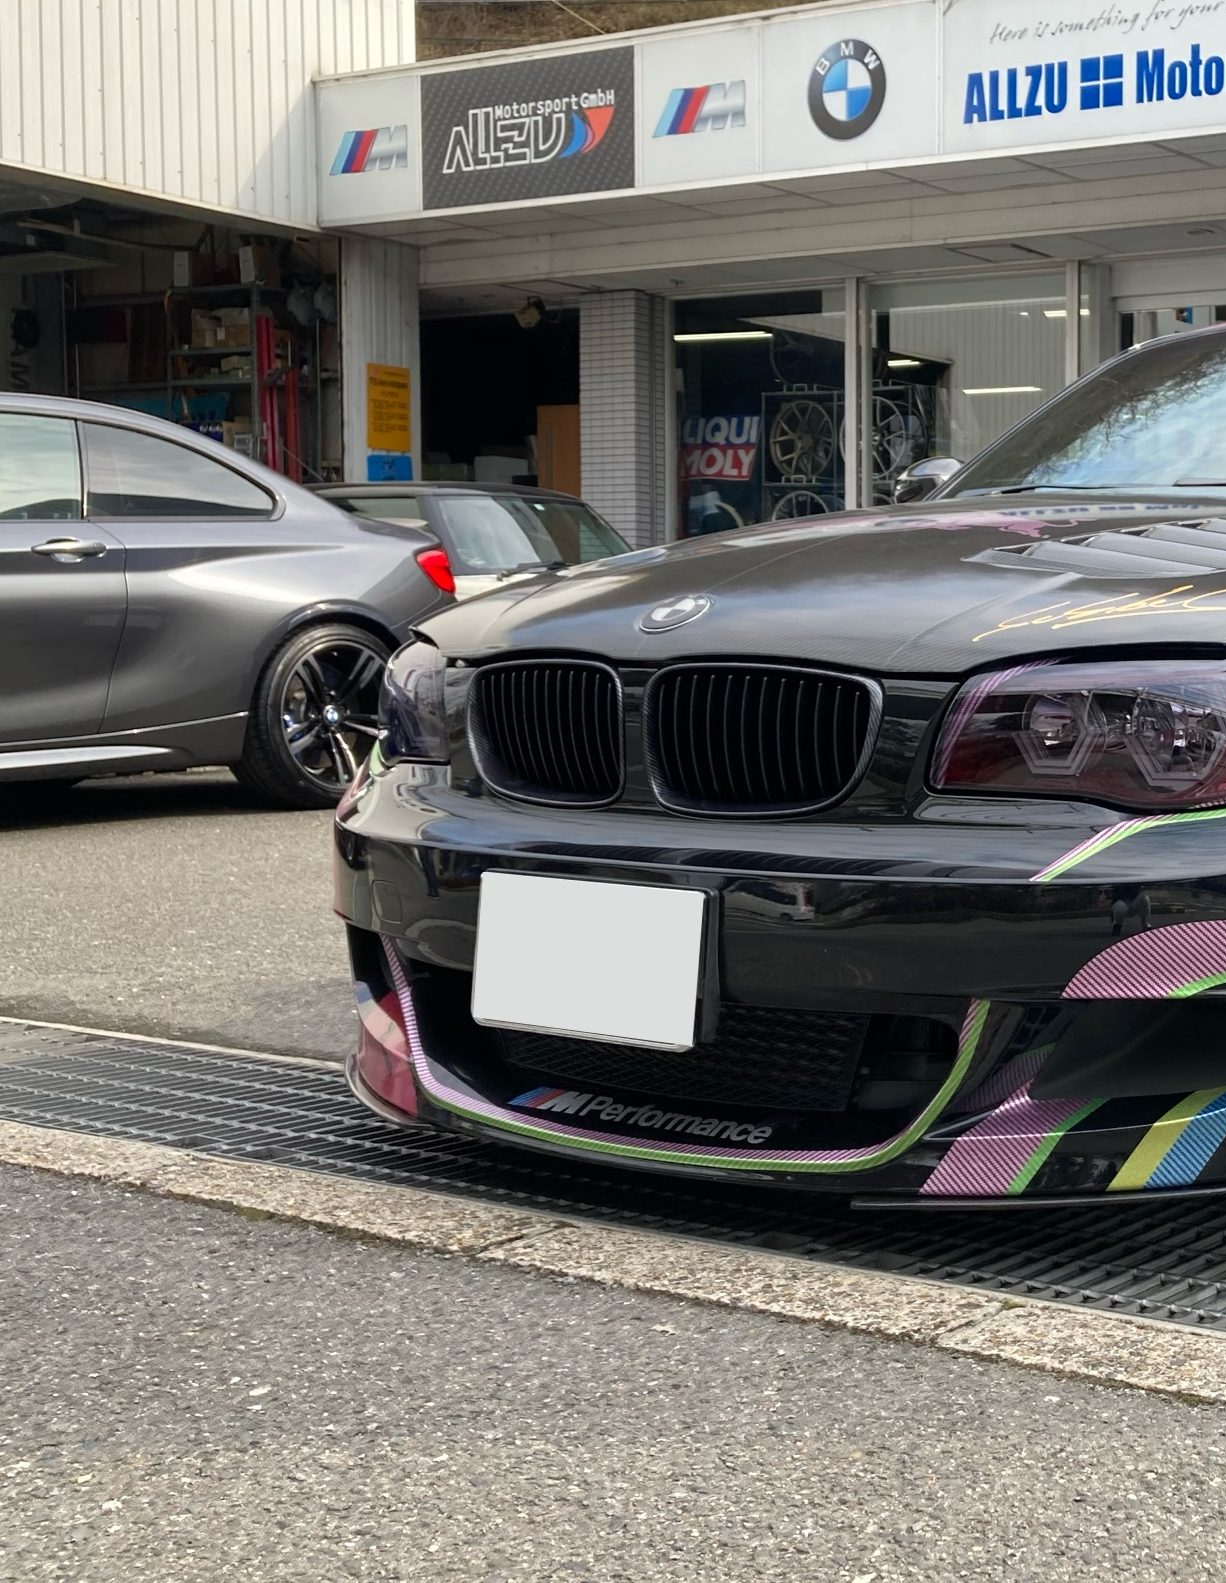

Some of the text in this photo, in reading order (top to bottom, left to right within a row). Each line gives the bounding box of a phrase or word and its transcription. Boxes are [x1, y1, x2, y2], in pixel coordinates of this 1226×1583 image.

[988, 0, 1225, 44] Here is something for your
[815, 40, 881, 76] BMW
[494, 88, 615, 120] Motorsport GmbH
[963, 60, 1067, 124] ALLZU
[683, 416, 760, 445] LIQUI
[680, 447, 757, 476] MOLY
[579, 1096, 773, 1144] Performance
